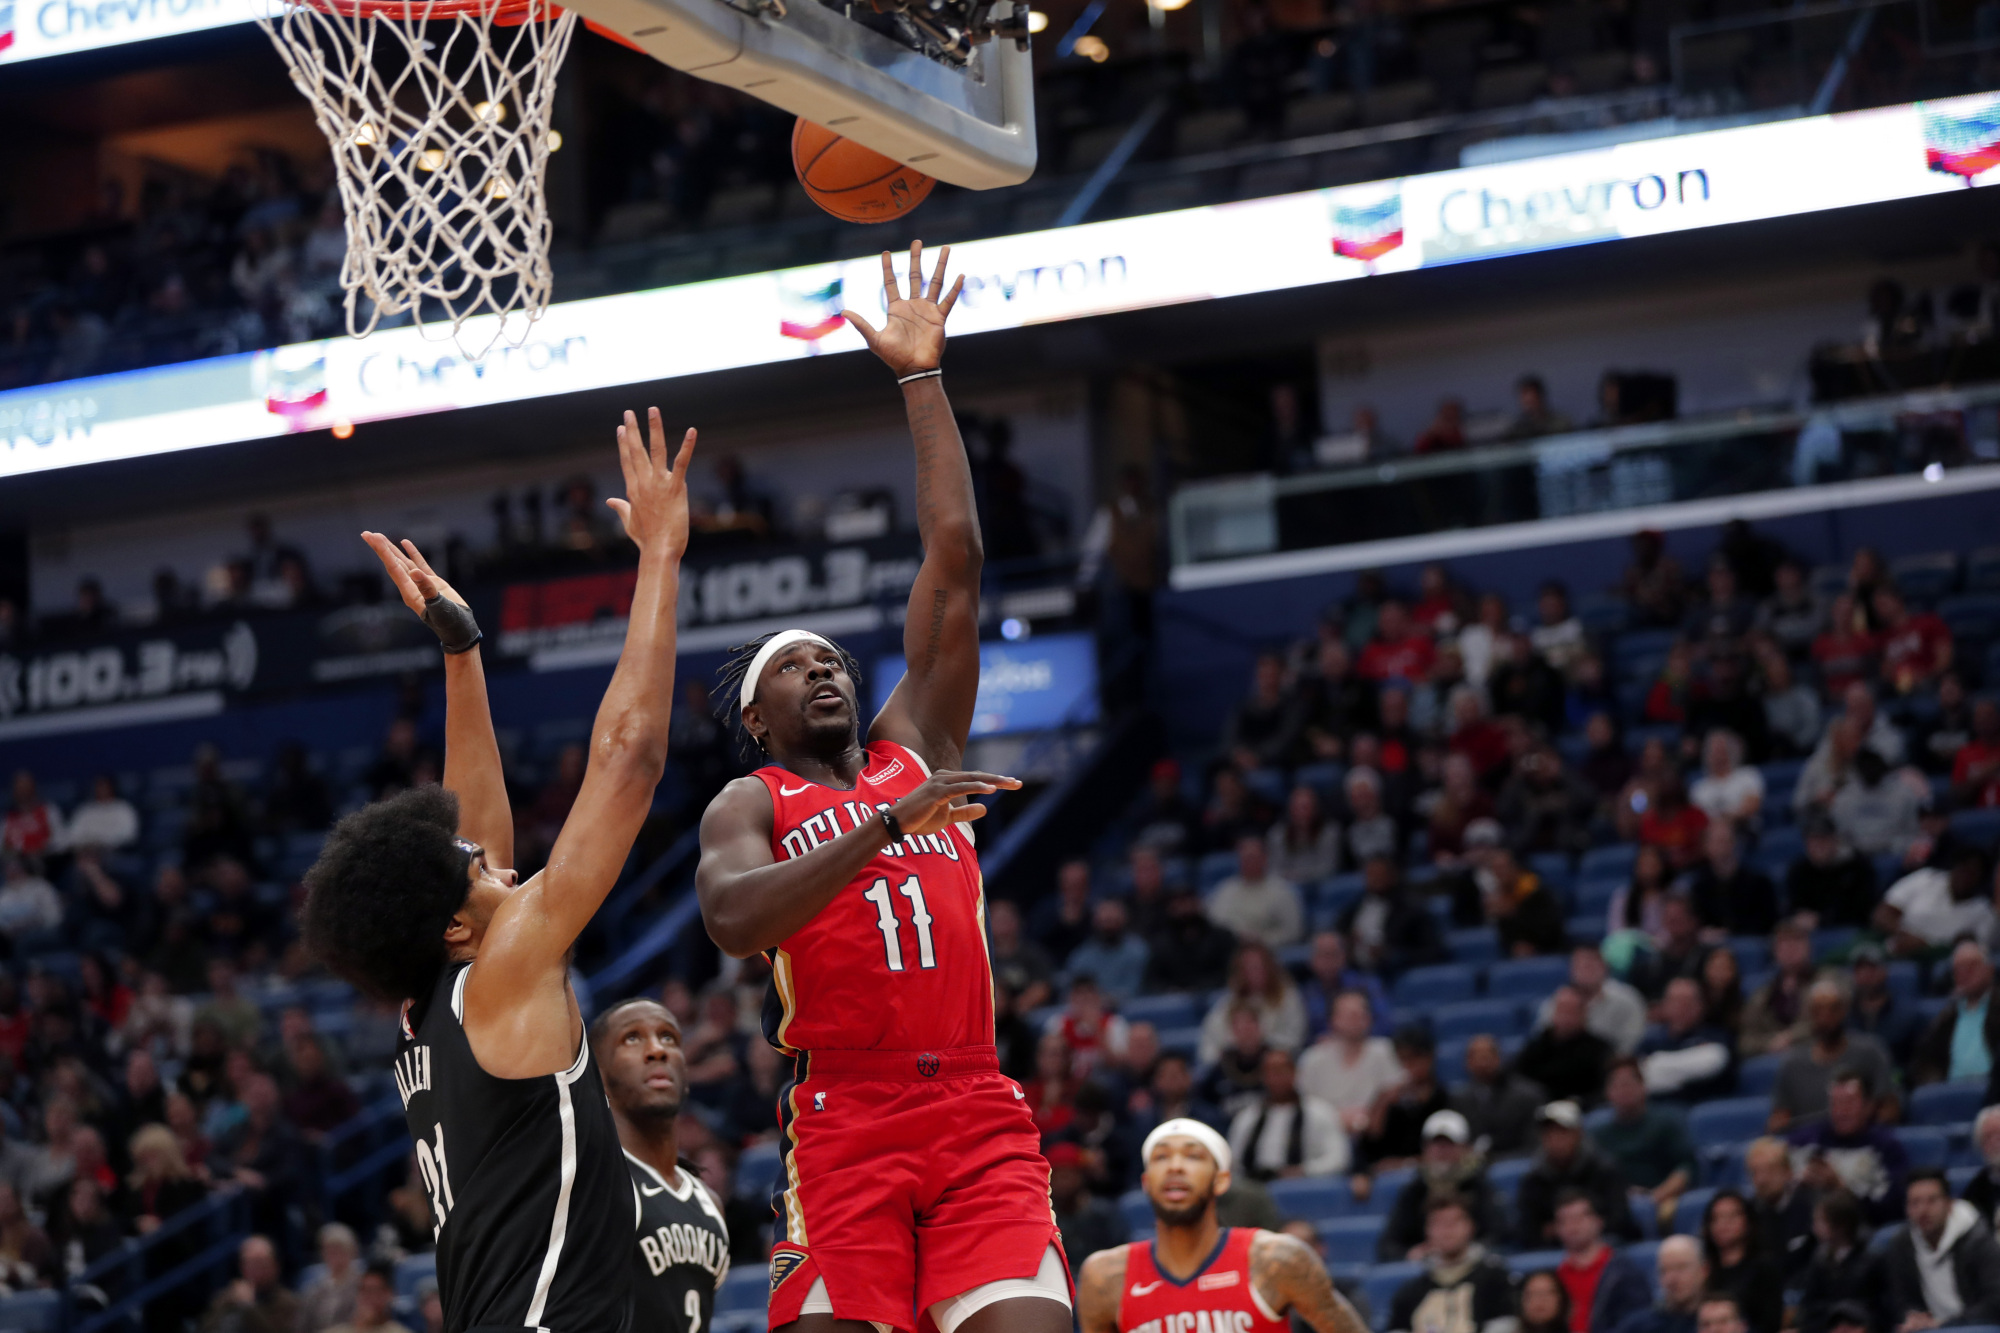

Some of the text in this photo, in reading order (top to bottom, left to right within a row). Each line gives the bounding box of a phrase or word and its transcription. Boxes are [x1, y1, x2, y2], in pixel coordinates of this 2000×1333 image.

[37, 0, 221, 39] Chevro
[1439, 168, 1710, 235] Chevron
[357, 334, 588, 397] Chevron
[702, 549, 870, 622] 100.3
[27, 637, 178, 708] 100.3
[863, 874, 938, 971] 11
[394, 1045, 431, 1112] ALLEN
[416, 1121, 455, 1245] 31
